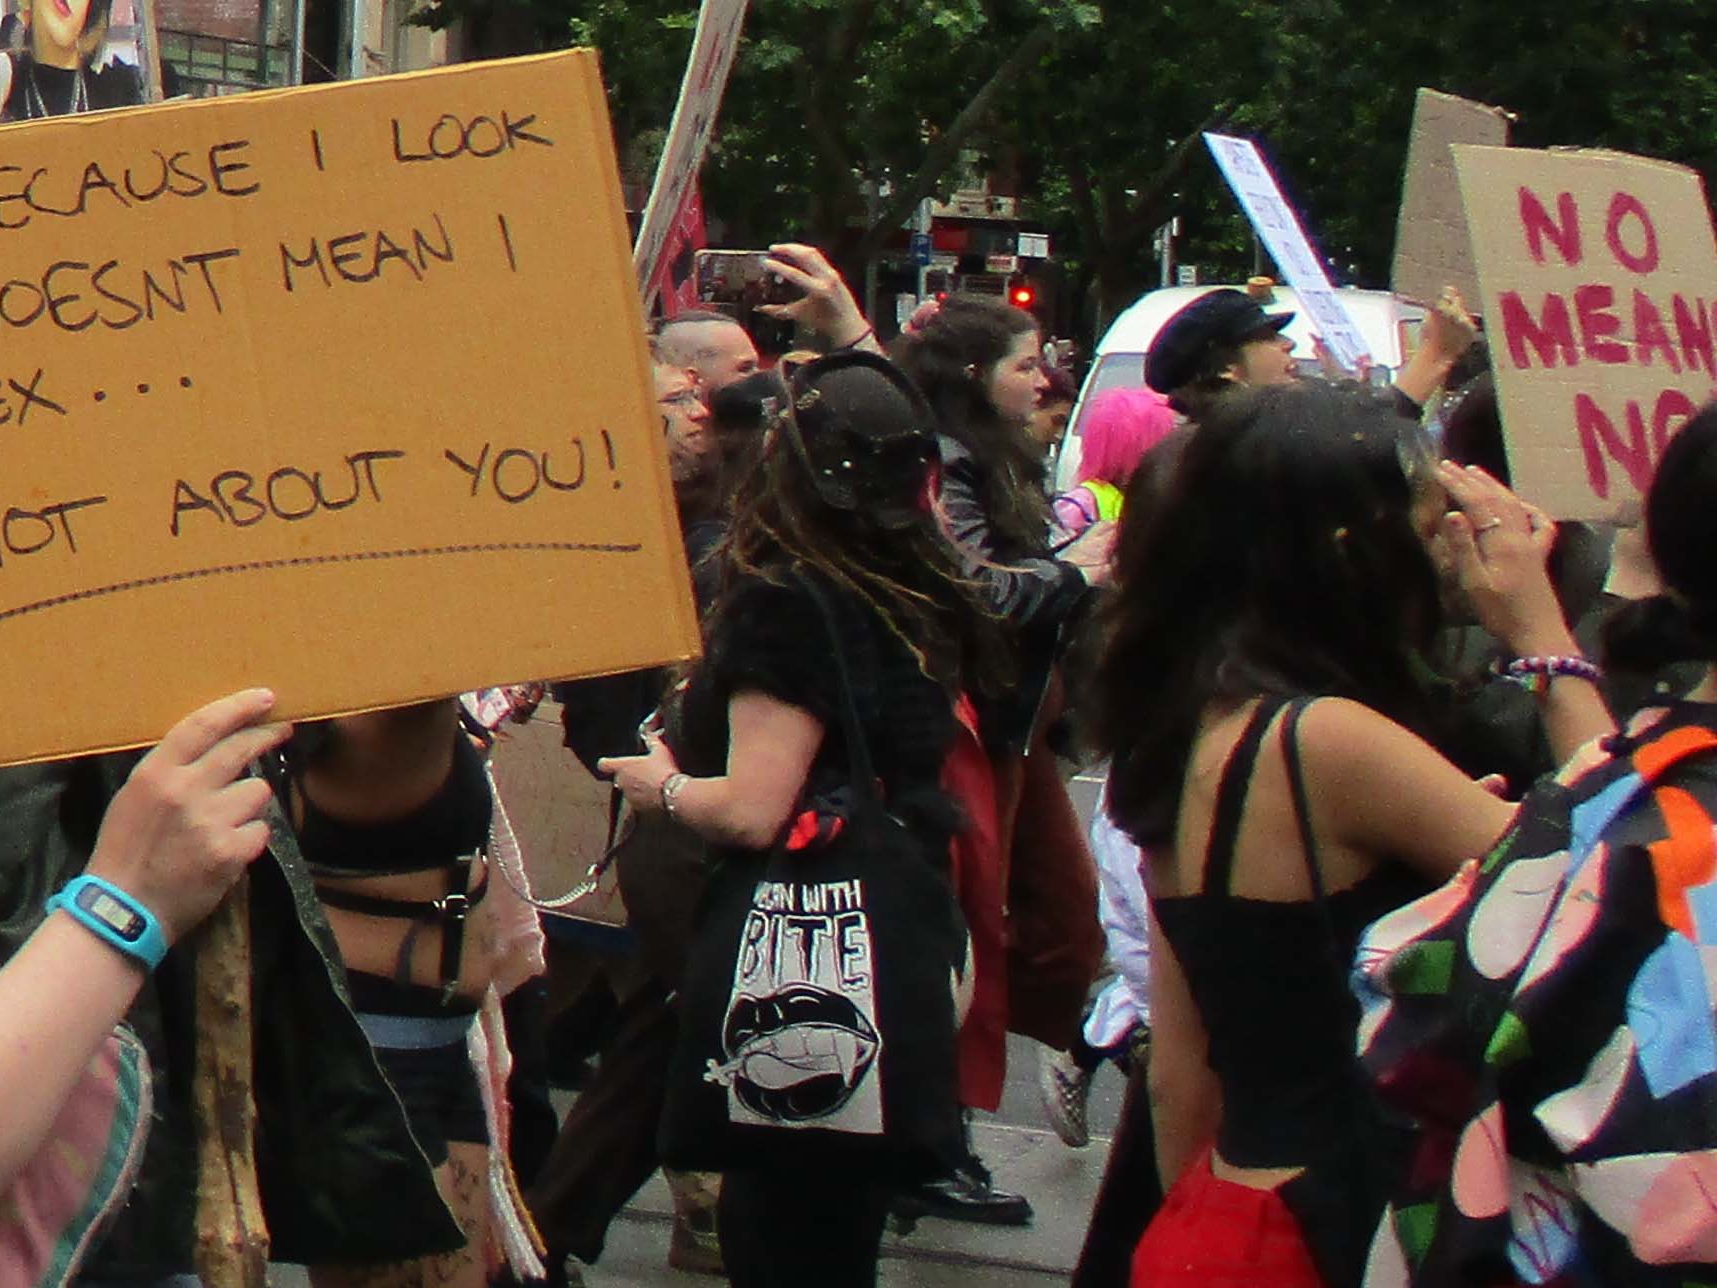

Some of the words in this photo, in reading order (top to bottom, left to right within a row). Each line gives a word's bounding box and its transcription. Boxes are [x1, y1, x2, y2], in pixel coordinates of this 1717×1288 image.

[310, 127, 325, 172] I
[390, 107, 555, 164] LOOK
[277, 228, 457, 298] MEAN
[497, 212, 518, 273] I
[1518, 184, 1660, 275] NO
[166, 448, 407, 541] ABOUT
[443, 427, 623, 506] YOU!
[802, 879, 862, 913] WITH
[738, 909, 869, 993] BITE
